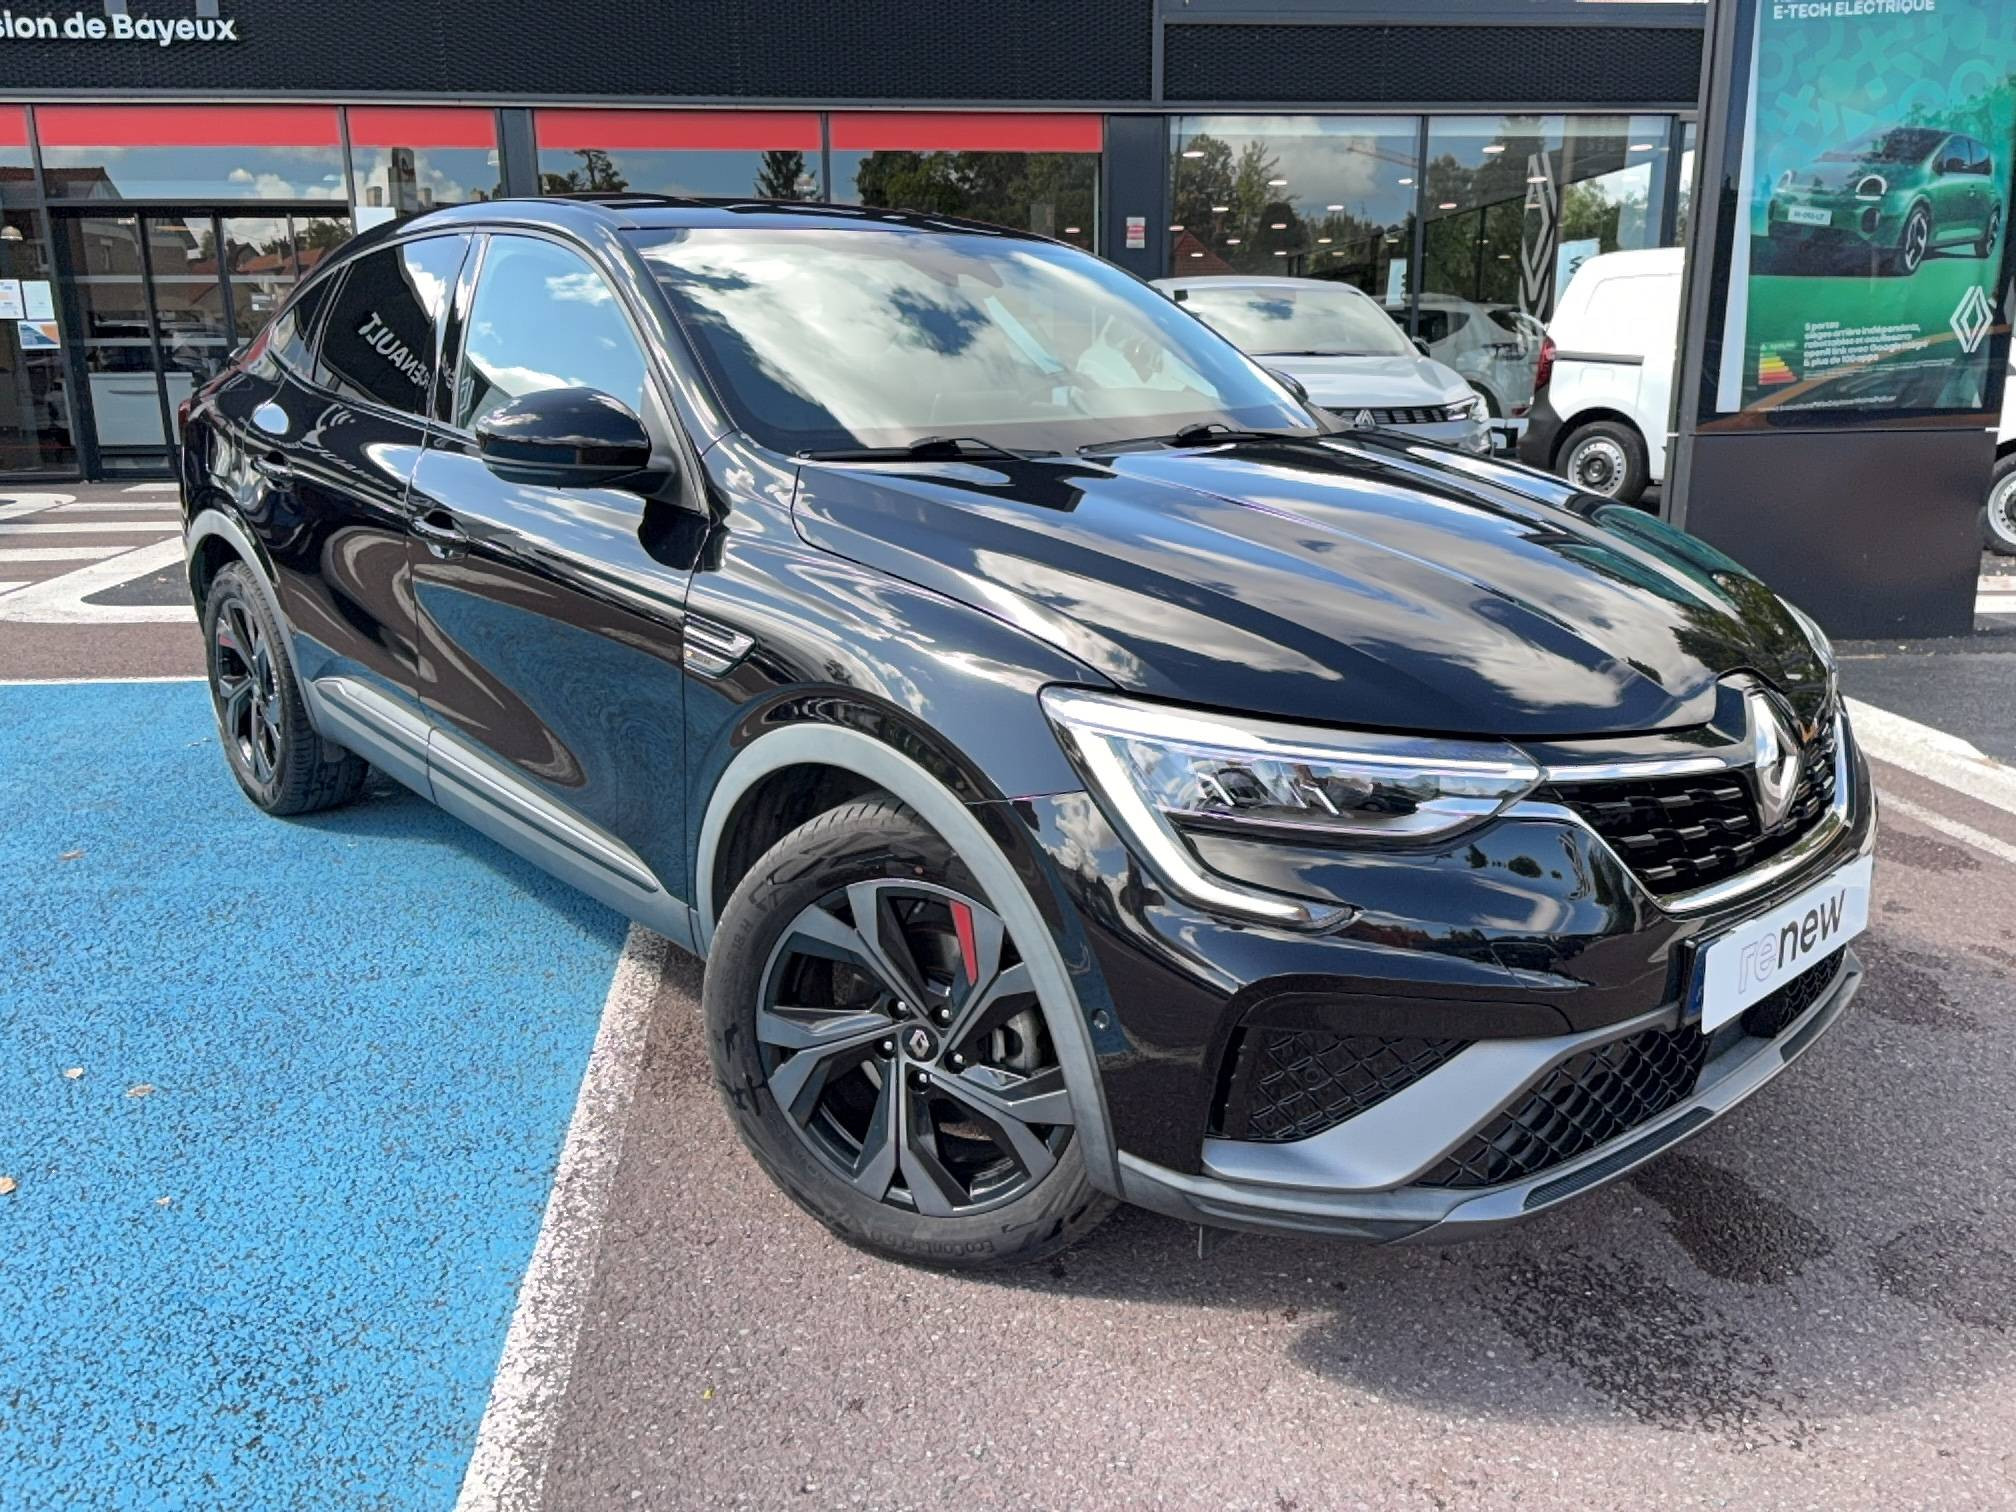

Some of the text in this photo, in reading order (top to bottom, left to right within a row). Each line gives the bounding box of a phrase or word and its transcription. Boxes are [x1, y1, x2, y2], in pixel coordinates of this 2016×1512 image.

[1773, 3, 1831, 19] E-TECH
[64, 12, 106, 39] de
[112, 14, 238, 46] Bayeux
[1738, 888, 1846, 995] renew
